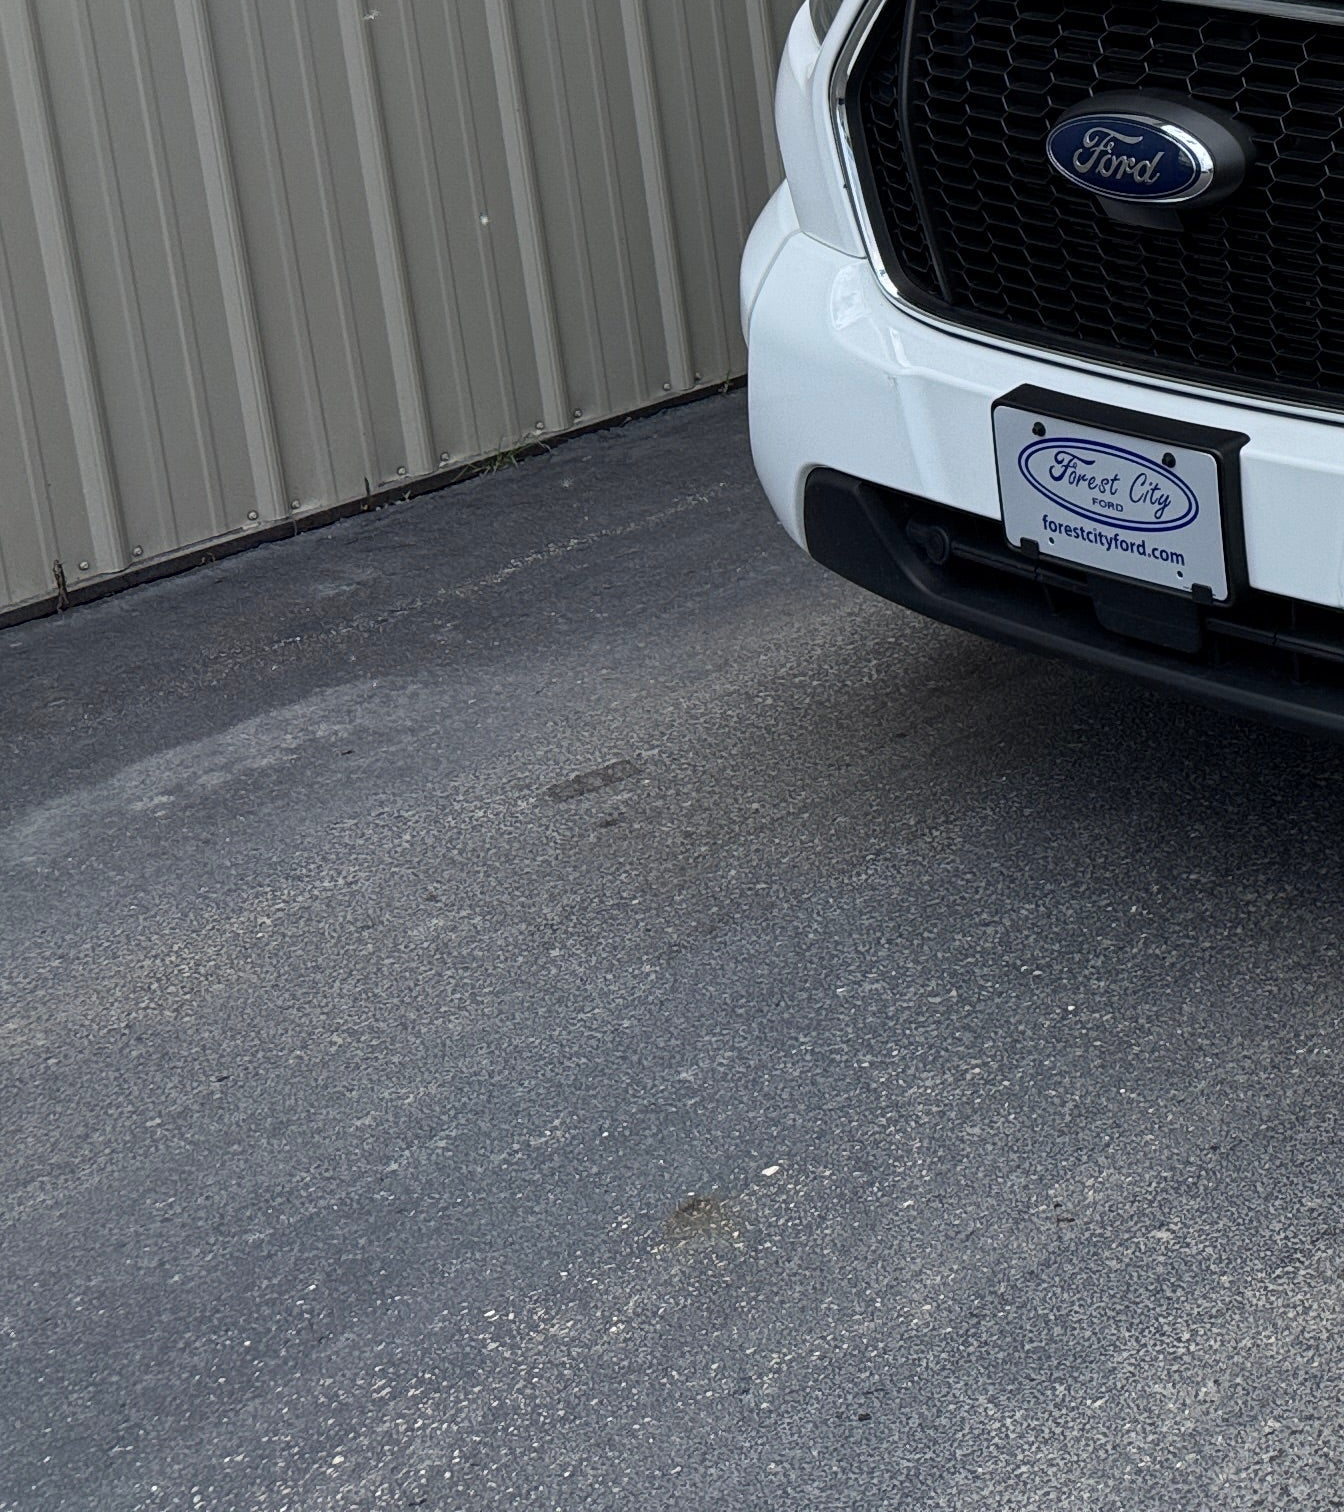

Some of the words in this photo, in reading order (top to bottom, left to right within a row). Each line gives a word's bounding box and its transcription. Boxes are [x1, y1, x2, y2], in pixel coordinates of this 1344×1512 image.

[1073, 127, 1165, 183] Ford
[1050, 451, 1120, 495] Forest
[1129, 473, 1171, 519] City
[1093, 498, 1124, 512] FORD
[1042, 515, 1185, 566] forestcityford.com
